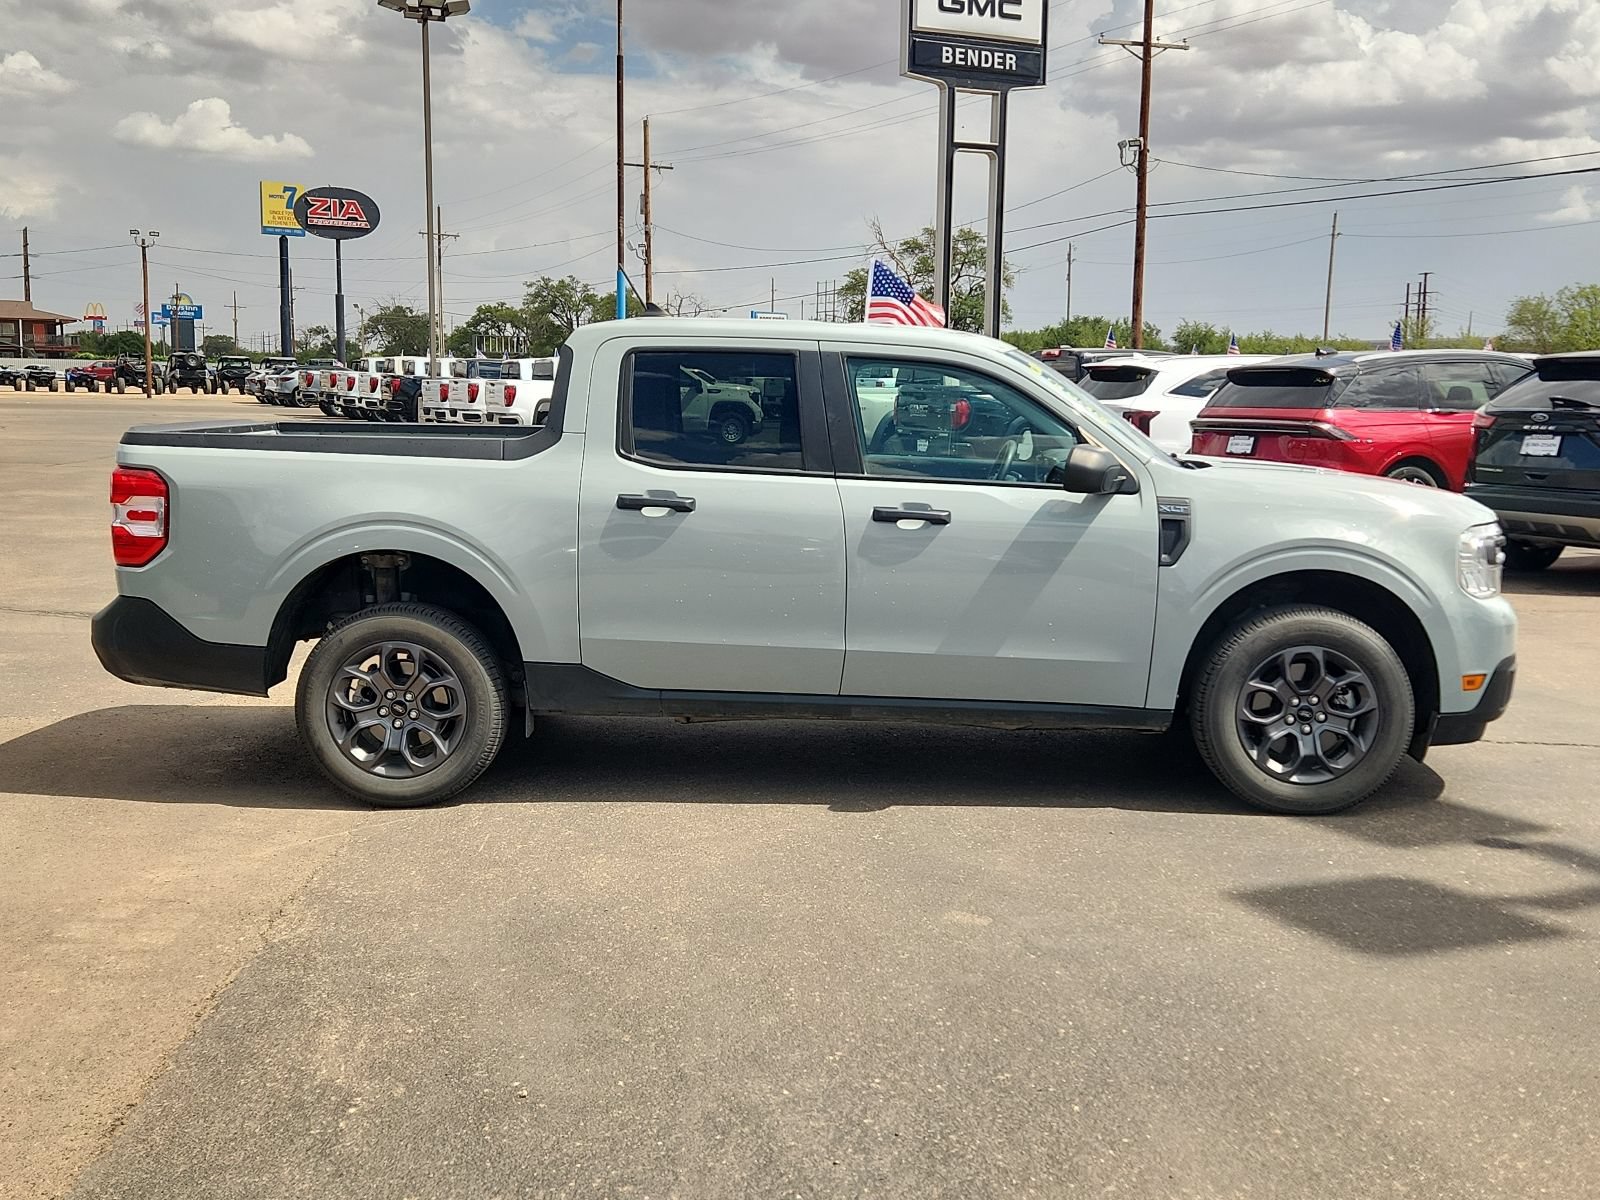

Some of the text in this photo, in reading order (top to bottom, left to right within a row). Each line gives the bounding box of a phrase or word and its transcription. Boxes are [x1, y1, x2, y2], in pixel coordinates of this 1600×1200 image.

[938, 0, 1022, 20] GMC
[942, 46, 1017, 70] BENDER
[283, 186, 297, 210] 7
[306, 196, 367, 221] ZIA
